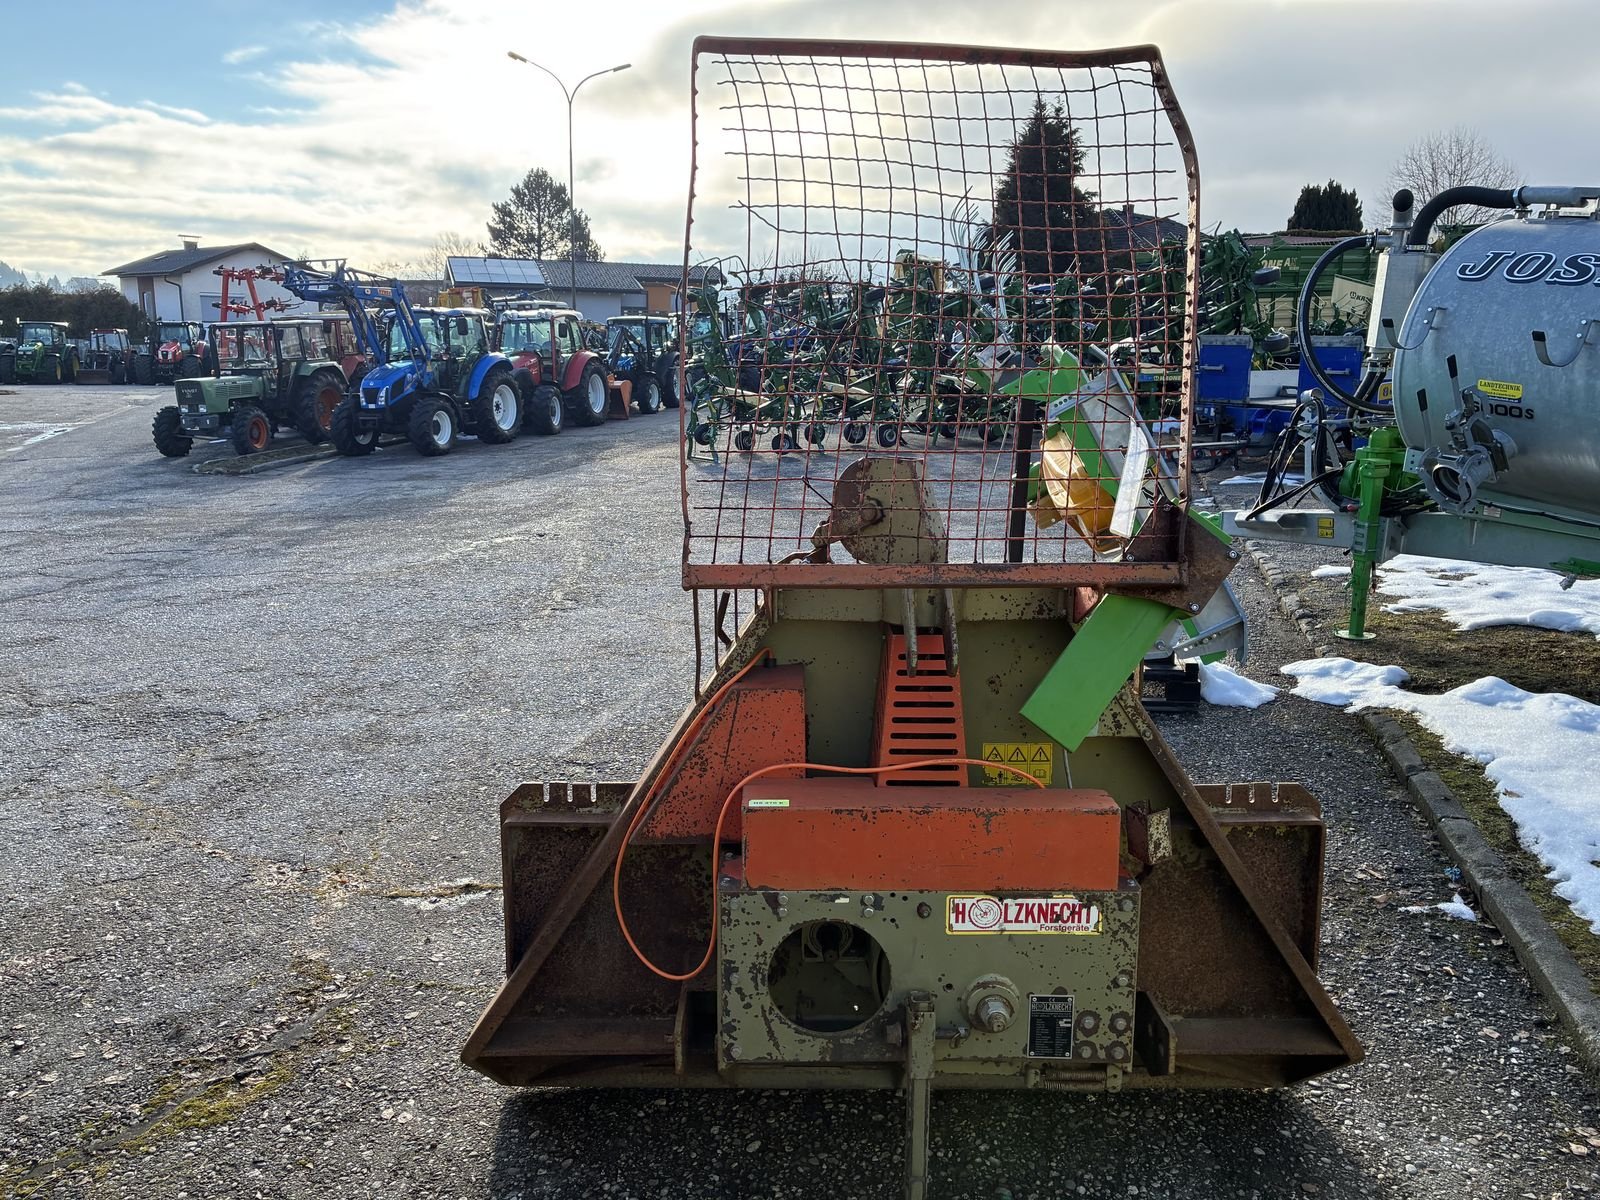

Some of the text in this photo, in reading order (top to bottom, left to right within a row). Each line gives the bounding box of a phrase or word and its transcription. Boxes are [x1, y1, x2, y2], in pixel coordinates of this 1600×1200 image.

[1456, 250, 1600, 287] JOS
[954, 897, 1092, 929] HOLZKNECHT
[1039, 923, 1091, 933] Forstgeräte
